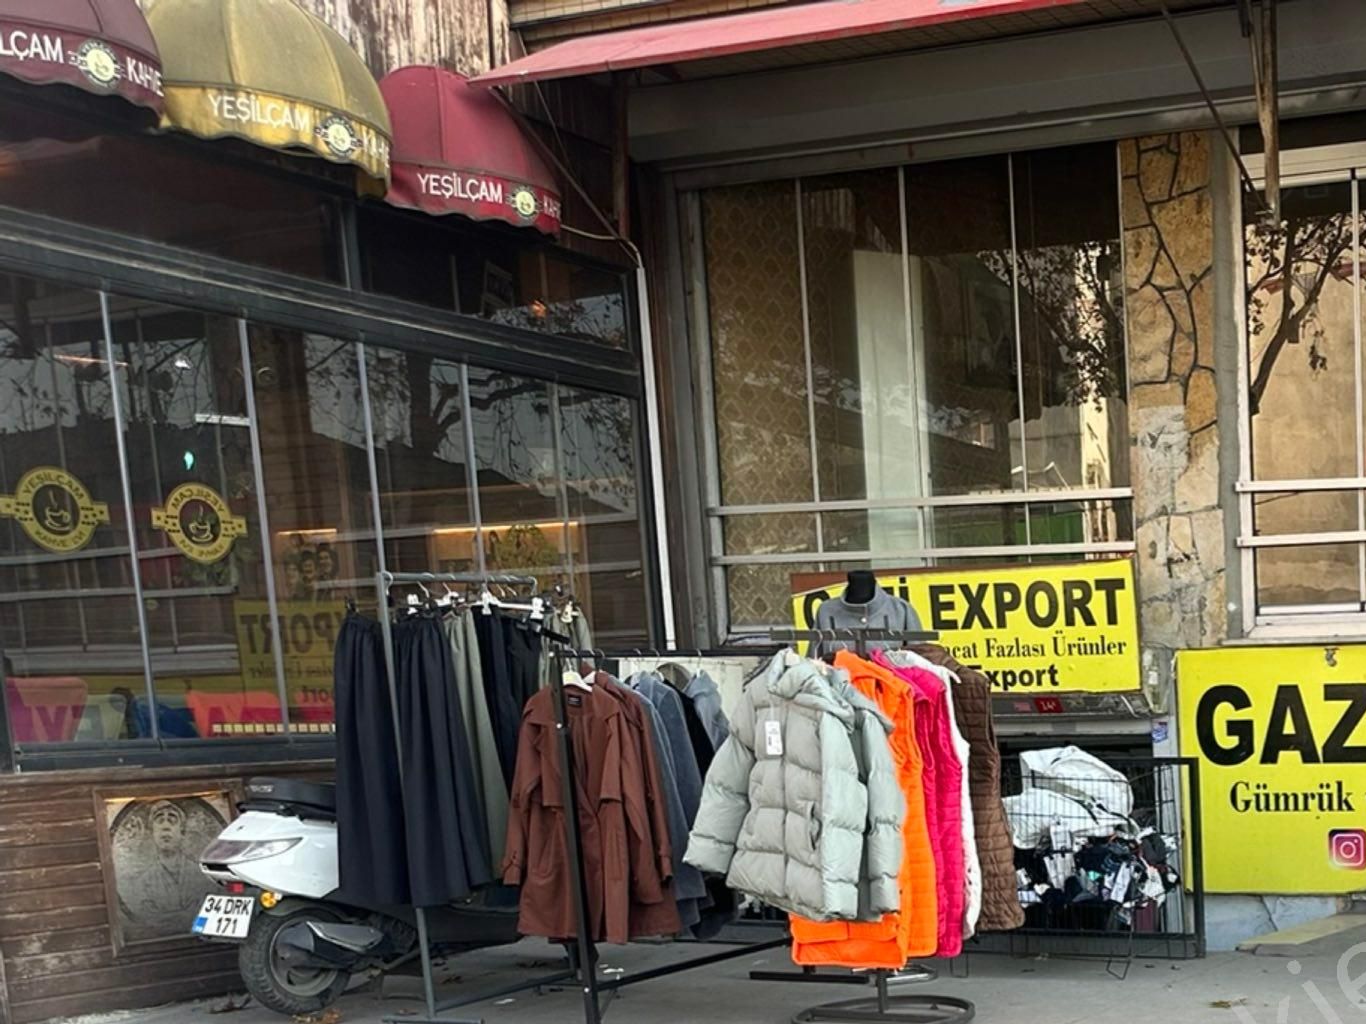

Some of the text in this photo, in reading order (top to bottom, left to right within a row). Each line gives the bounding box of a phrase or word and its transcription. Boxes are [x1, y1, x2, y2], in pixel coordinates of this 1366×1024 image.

[0, 30, 64, 64] LÇAM
[207, 93, 311, 133] YEŞİLÇAM
[416, 172, 503, 204] YEŞİLÇAM
[928, 578, 1126, 630] EXPORT
[985, 637, 1046, 659] Fazlası
[1052, 630, 1127, 657] Ürünler
[1229, 779, 1354, 813] Gümrük
[204, 897, 252, 916] 34 DRK
[215, 917, 239, 935] 171
